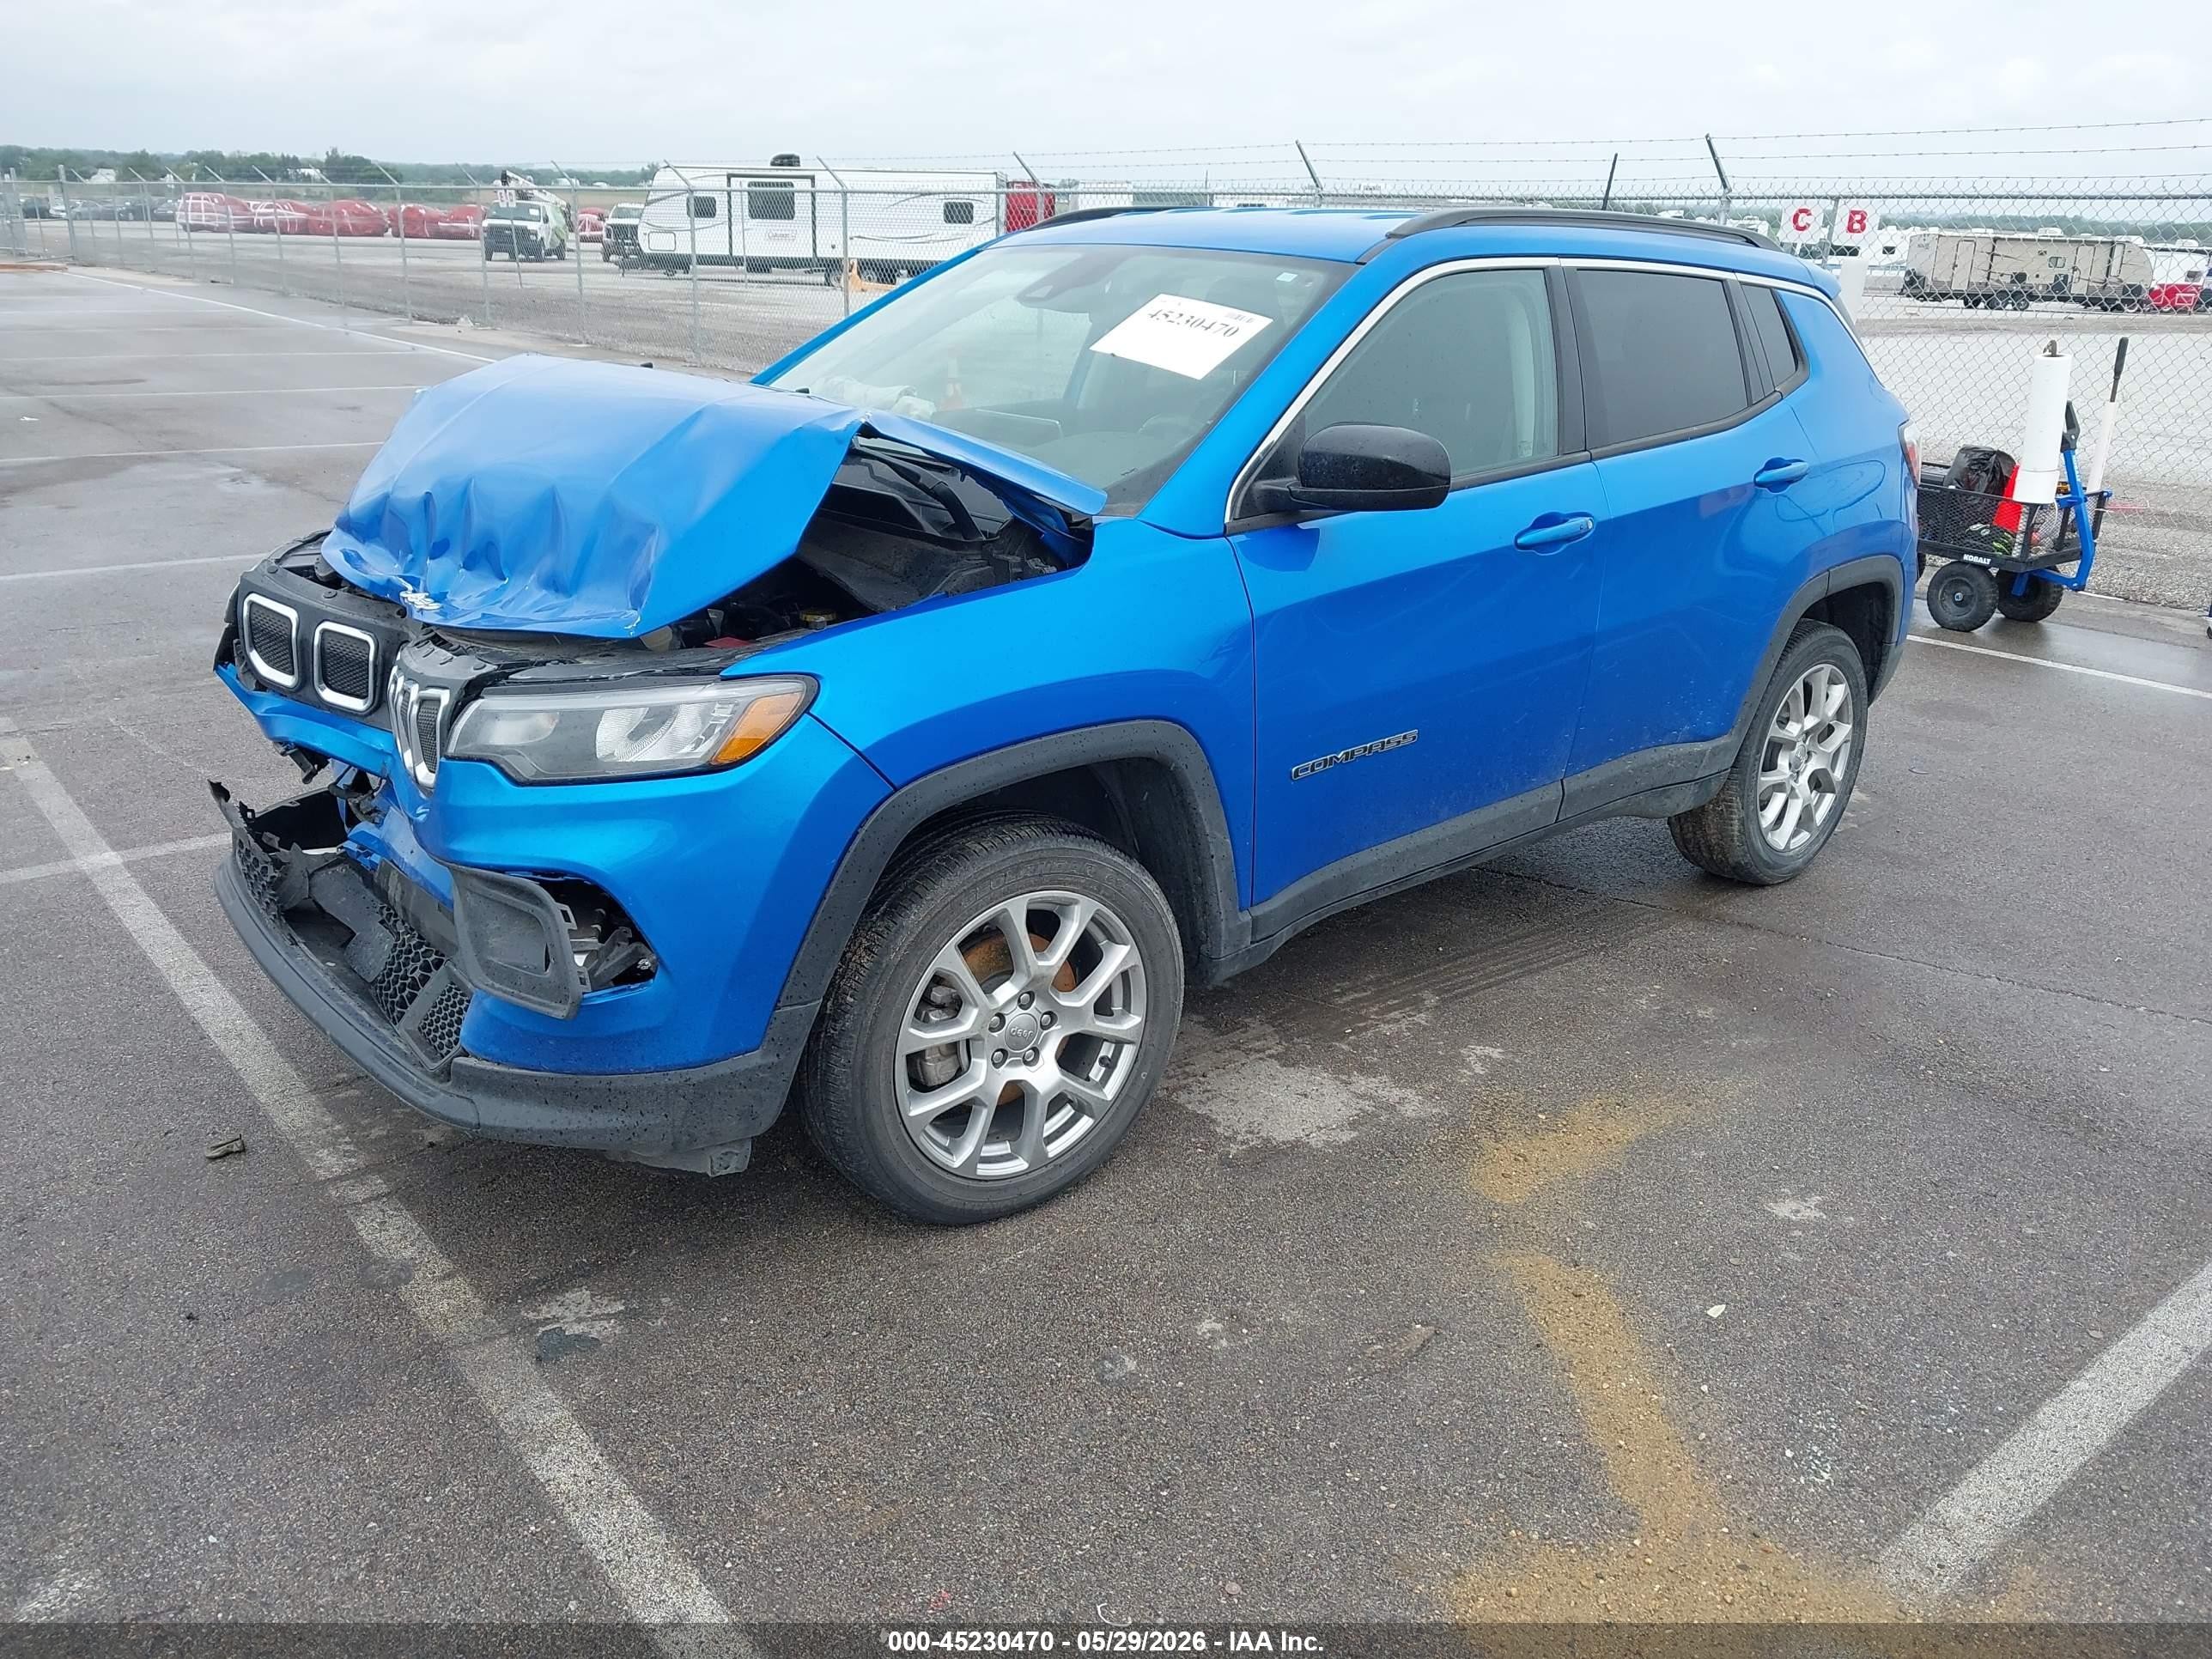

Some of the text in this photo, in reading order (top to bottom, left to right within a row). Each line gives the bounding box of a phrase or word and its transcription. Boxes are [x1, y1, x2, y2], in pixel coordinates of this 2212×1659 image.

[1792, 207, 1814, 232] C
[1846, 209, 1869, 234] B
[1147, 308, 1240, 337] 45230470
[1962, 553, 1992, 566] KOBALT
[1291, 728, 1419, 781] COMPASS
